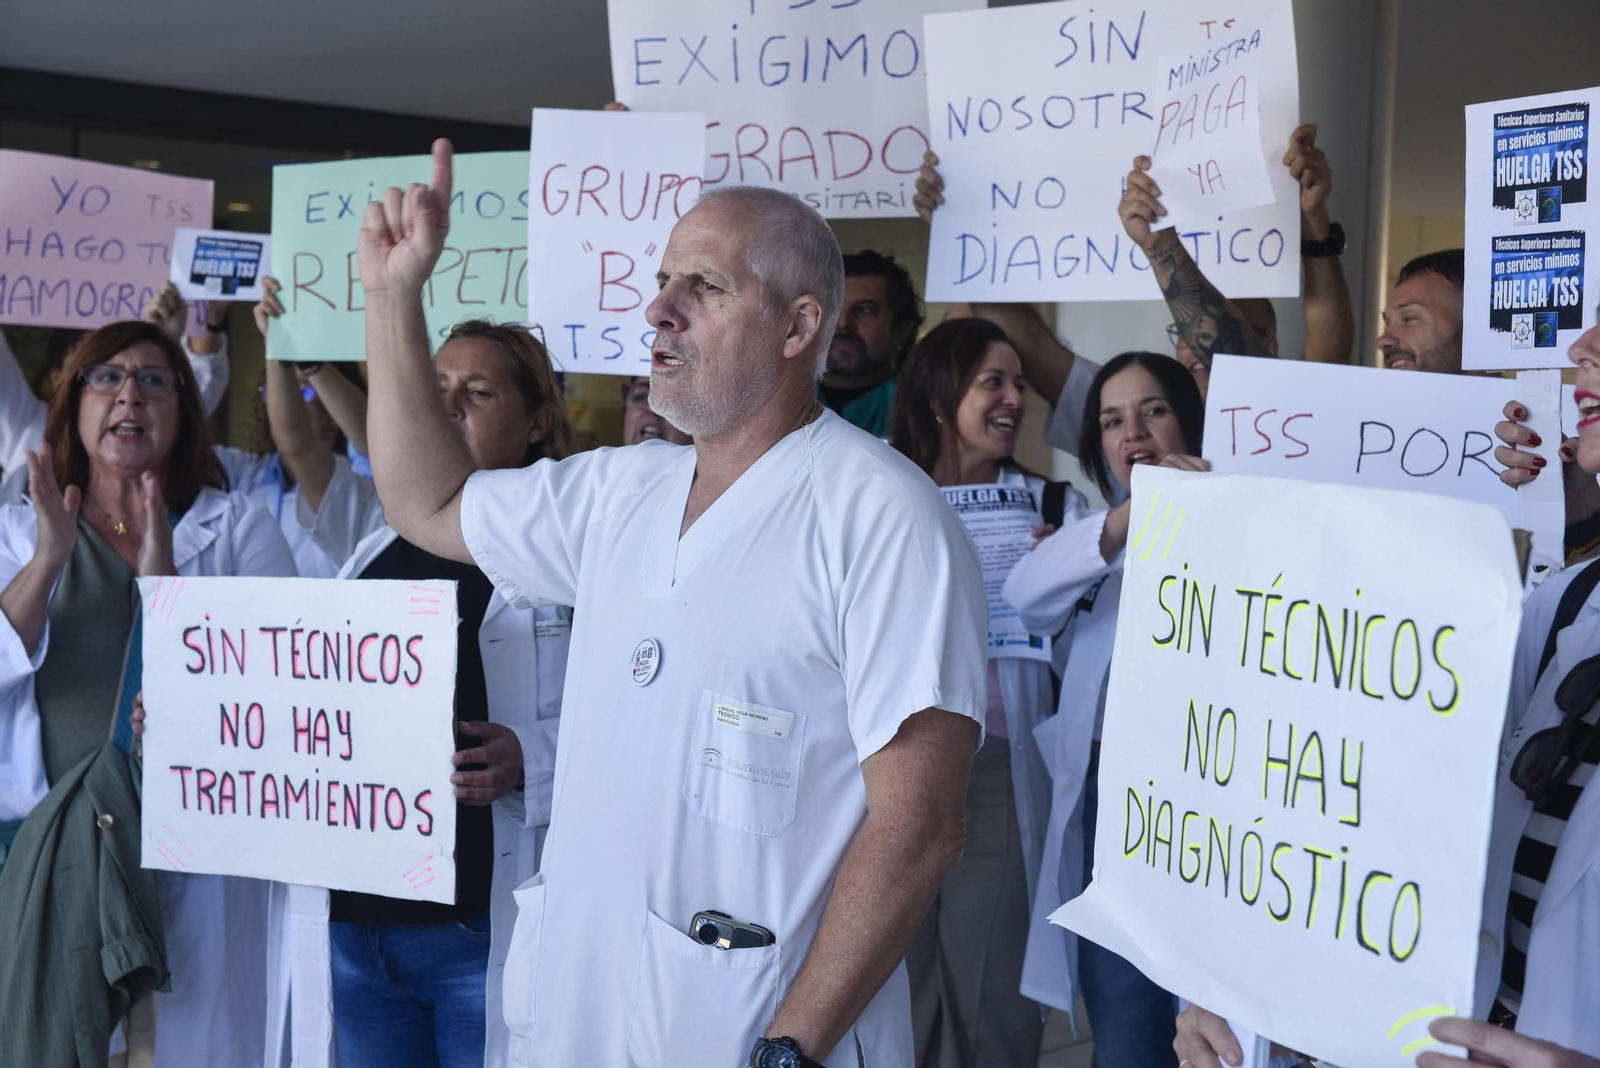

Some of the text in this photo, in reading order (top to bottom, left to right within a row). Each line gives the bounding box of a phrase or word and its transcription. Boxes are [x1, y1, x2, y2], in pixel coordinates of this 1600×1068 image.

[634, 23, 922, 86] EXIGIMO
[1055, 9, 1146, 68] SIN
[1168, 29, 1261, 91] MINISTRA
[948, 92, 1154, 140] NOSOTR
[1153, 75, 1247, 155] PAGA
[1497, 109, 1585, 128] Técnicos Superiores Sanitarios
[1497, 125, 1584, 152] en servicios mínimos
[1187, 159, 1226, 196] YA
[1496, 148, 1583, 188] HUELGA TSS
[51, 176, 195, 223] YO TSS
[542, 164, 705, 222] GRUPO
[991, 177, 1066, 211] NO
[6, 227, 127, 265] HAGO
[1495, 252, 1580, 275] en servicios mínimos
[1520, 237, 1551, 251] Superiores
[1551, 236, 1581, 250] Sanitarios
[293, 246, 529, 313] REPET
[1493, 275, 1580, 310] HUELGA TSS
[1220, 406, 1501, 477] TSS POR
[182, 613, 424, 688] SIN TÉCNICOS
[1152, 562, 1462, 716] SIN TÉCNICOS
[219, 702, 353, 761] NO HAY
[717, 710, 740, 721] TECNICO
[748, 713, 769, 722] MORENO
[760, 768, 769, 777] DE
[769, 769, 791, 780] SALUD
[1183, 698, 1364, 827] NO HAY
[169, 766, 434, 837] TRATAMIENTOS
[1123, 781, 1422, 963] DIAGNÓSTICO
